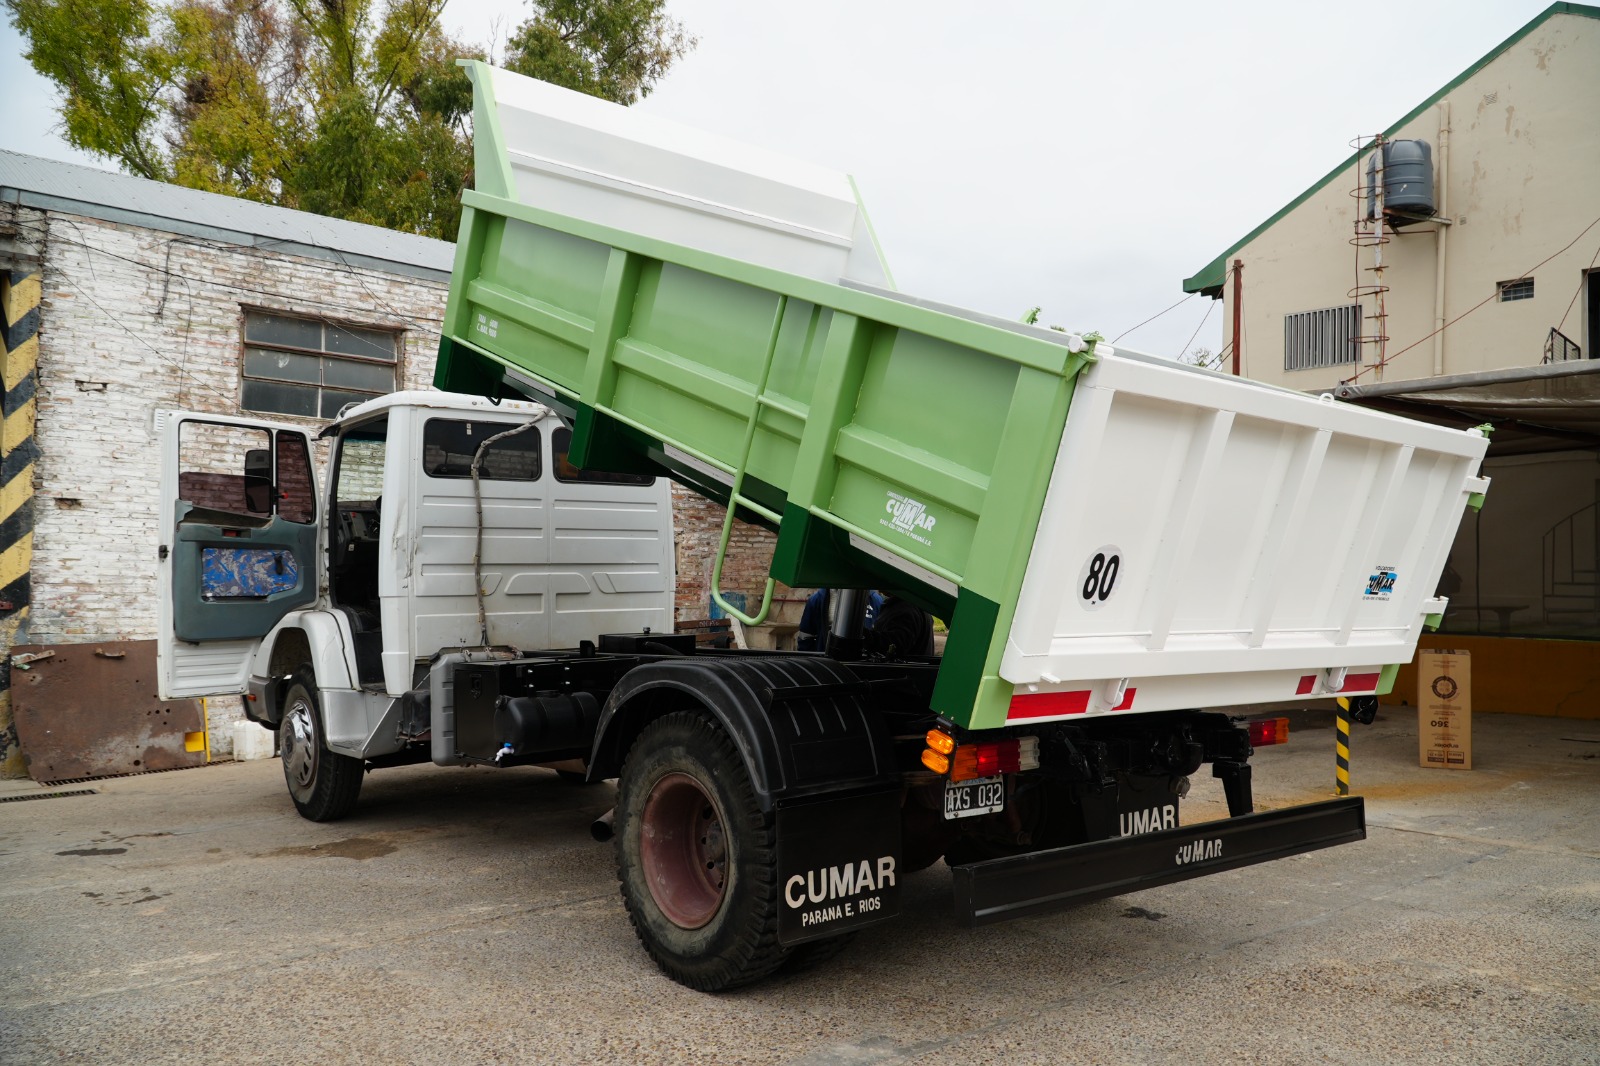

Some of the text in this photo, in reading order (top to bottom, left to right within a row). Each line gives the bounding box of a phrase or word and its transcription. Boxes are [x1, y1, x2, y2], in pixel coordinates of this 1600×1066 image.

[886, 498, 936, 532] CUMAR
[1083, 552, 1120, 601] 80
[1430, 720, 1449, 728] 360
[947, 783, 1002, 812] AXS 032
[1120, 804, 1176, 837] UMAR
[1175, 839, 1223, 865] CUMAR
[784, 855, 896, 909] CUMAR
[802, 904, 842, 927] PARANA
[859, 896, 881, 914] RIOS
